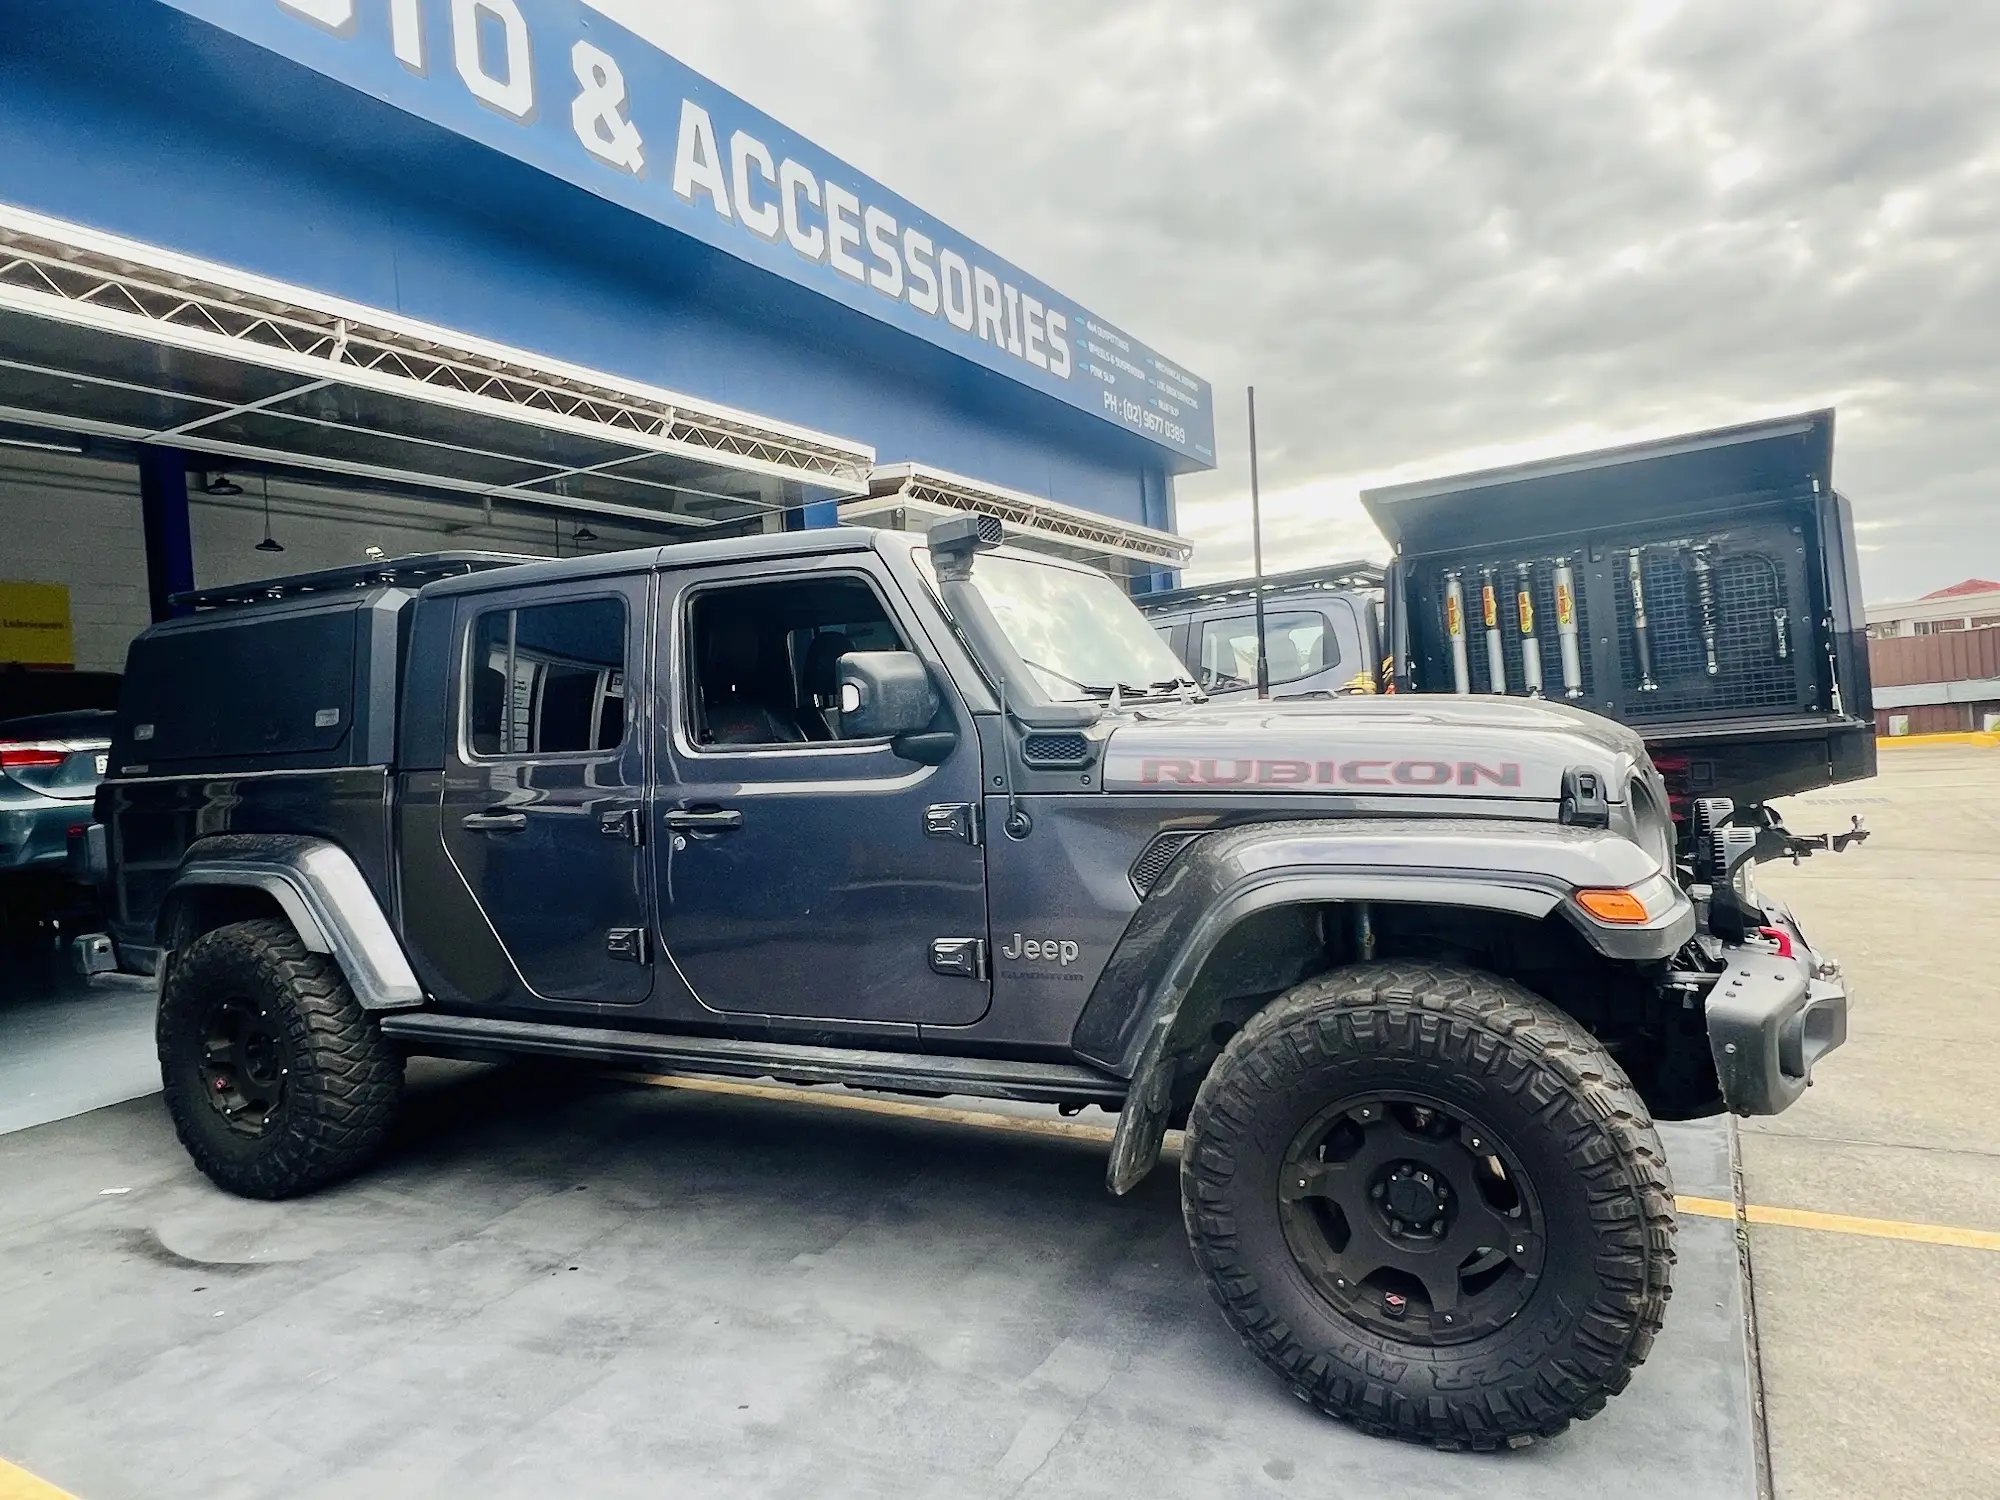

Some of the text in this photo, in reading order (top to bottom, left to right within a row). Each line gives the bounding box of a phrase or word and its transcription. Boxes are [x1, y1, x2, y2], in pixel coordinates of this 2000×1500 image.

[571, 39, 644, 173] &
[673, 98, 1071, 380] ACCESSORIES
[1123, 397, 1142, 428] (02)
[1142, 410, 1164, 434] 9677
[1164, 420, 1186, 444] 0389
[1141, 759, 1521, 787] RUBICON
[1002, 932, 1079, 967] Jeep
